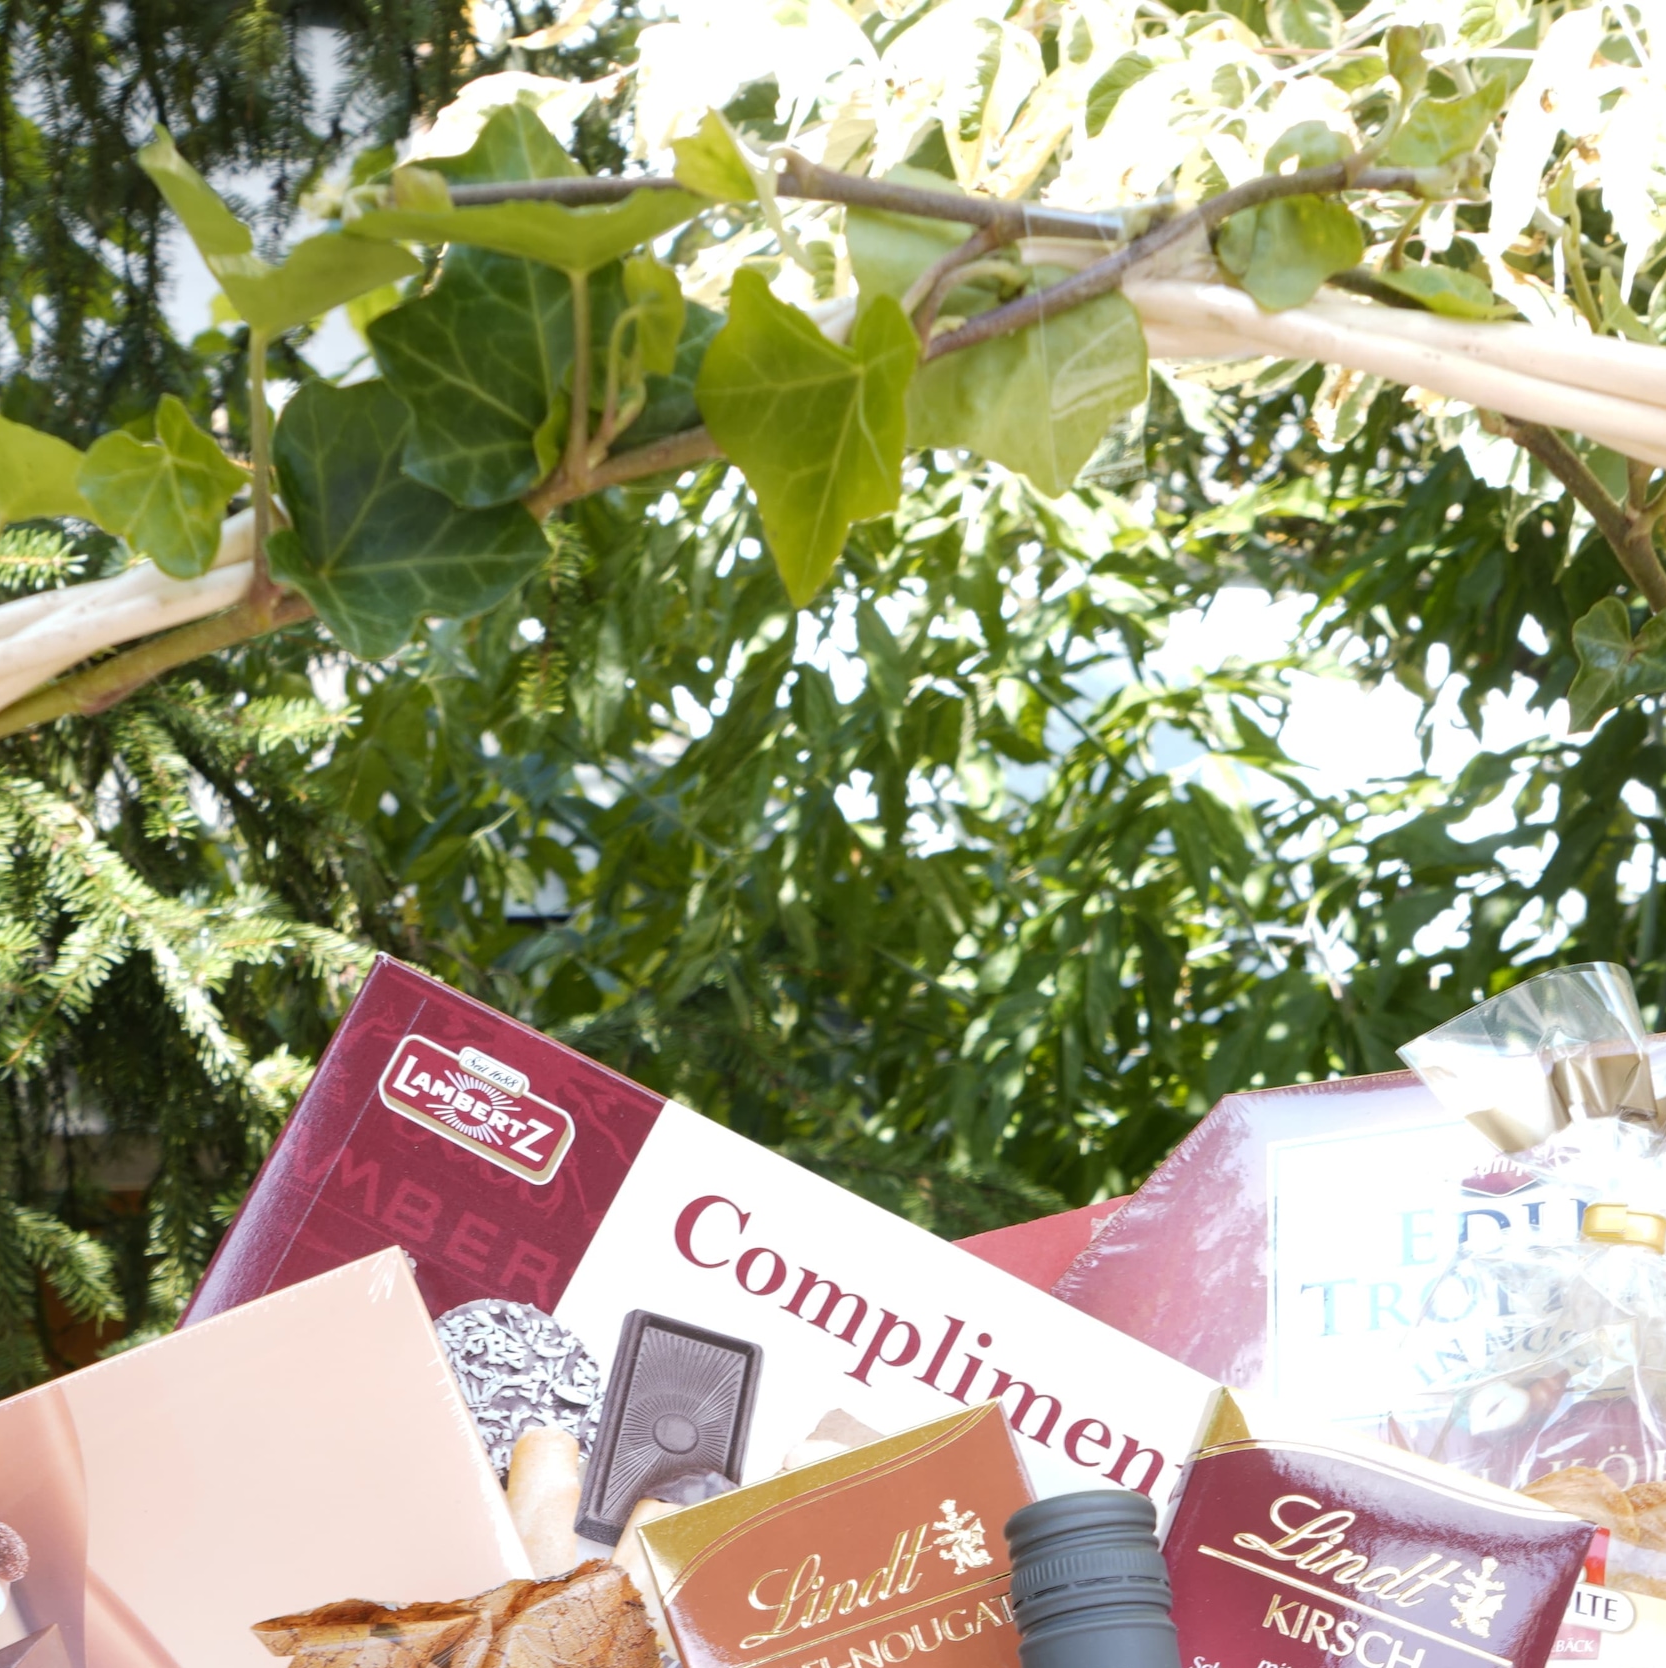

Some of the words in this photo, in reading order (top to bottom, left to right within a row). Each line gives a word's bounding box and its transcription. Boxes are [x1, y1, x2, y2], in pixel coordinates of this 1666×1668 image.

[465, 1056, 487, 1074] Seit
[488, 1068, 520, 1088] 1688
[674, 1195, 1190, 1500] Complimen
[740, 1523, 933, 1649] Lindt
[1234, 1494, 1461, 1608] Lindt
[1552, 1637, 1595, 1653] BÄCK
